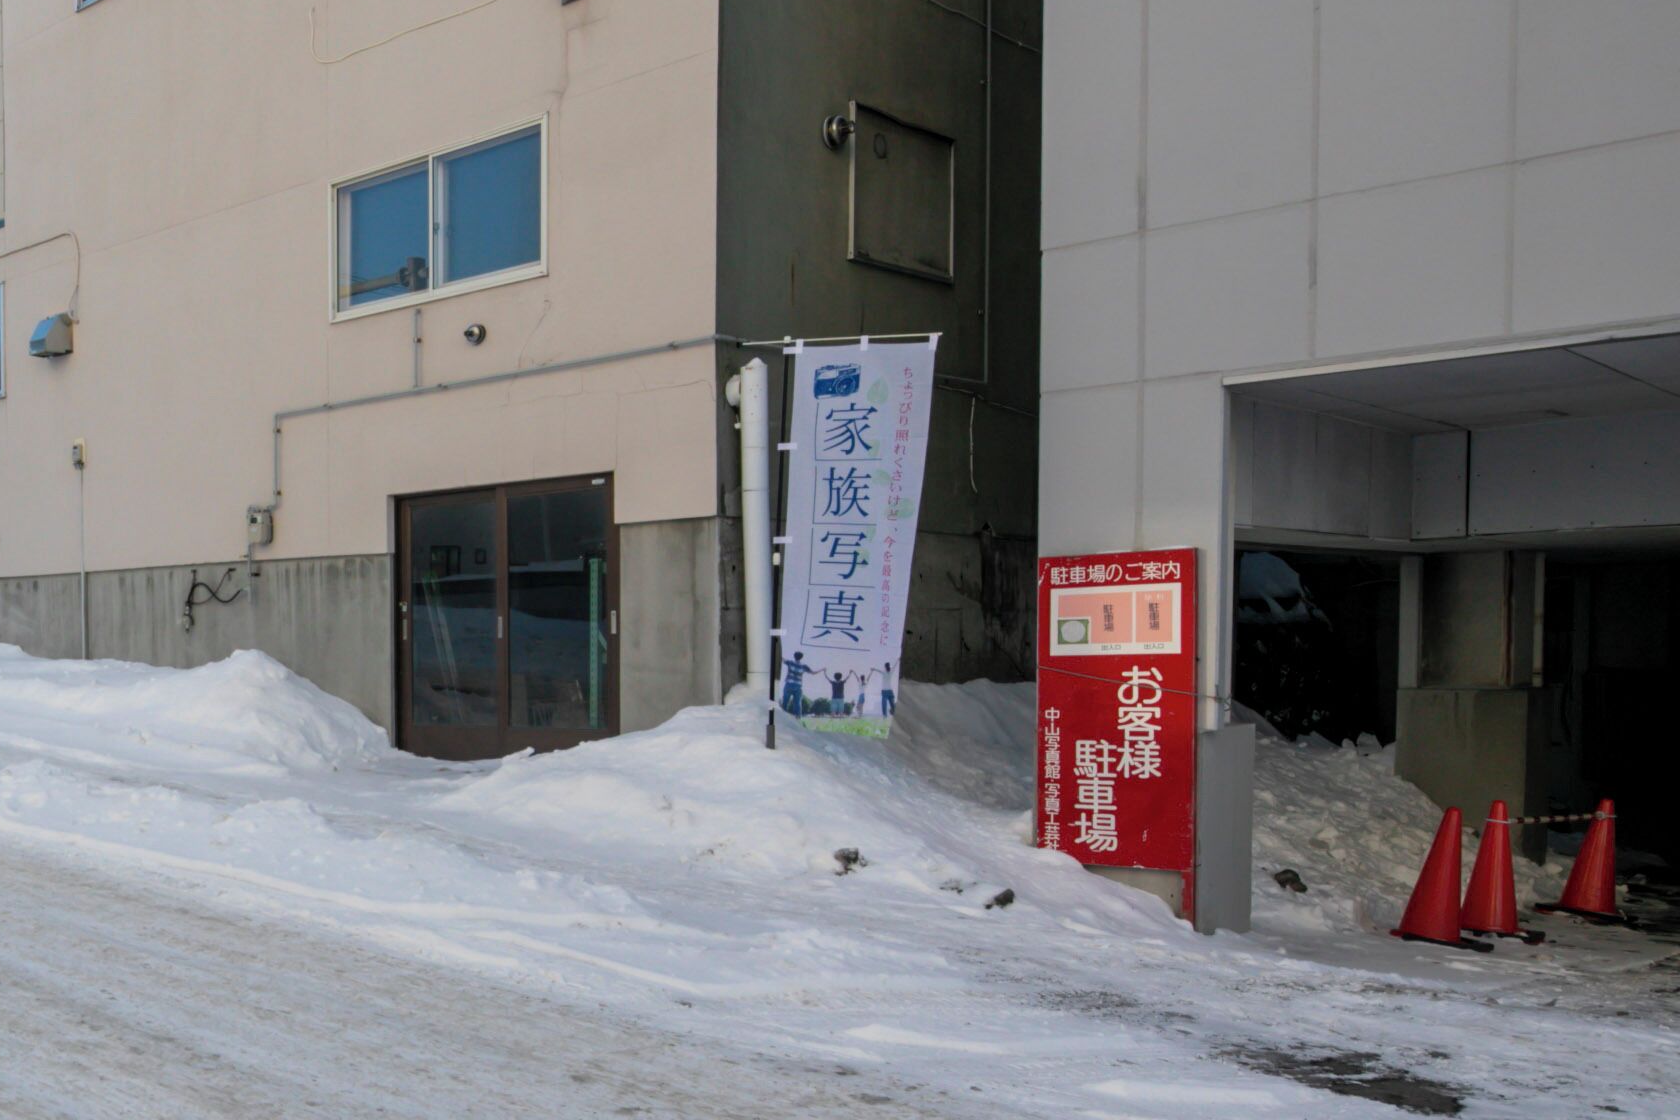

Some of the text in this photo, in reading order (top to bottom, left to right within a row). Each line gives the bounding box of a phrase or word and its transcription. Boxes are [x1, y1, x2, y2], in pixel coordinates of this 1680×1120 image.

[812, 401, 877, 643] 家族写真
[1050, 560, 1181, 585] 駐車場のご案内
[1117, 665, 1162, 779] お客様
[1073, 739, 1118, 852] 駐車場
